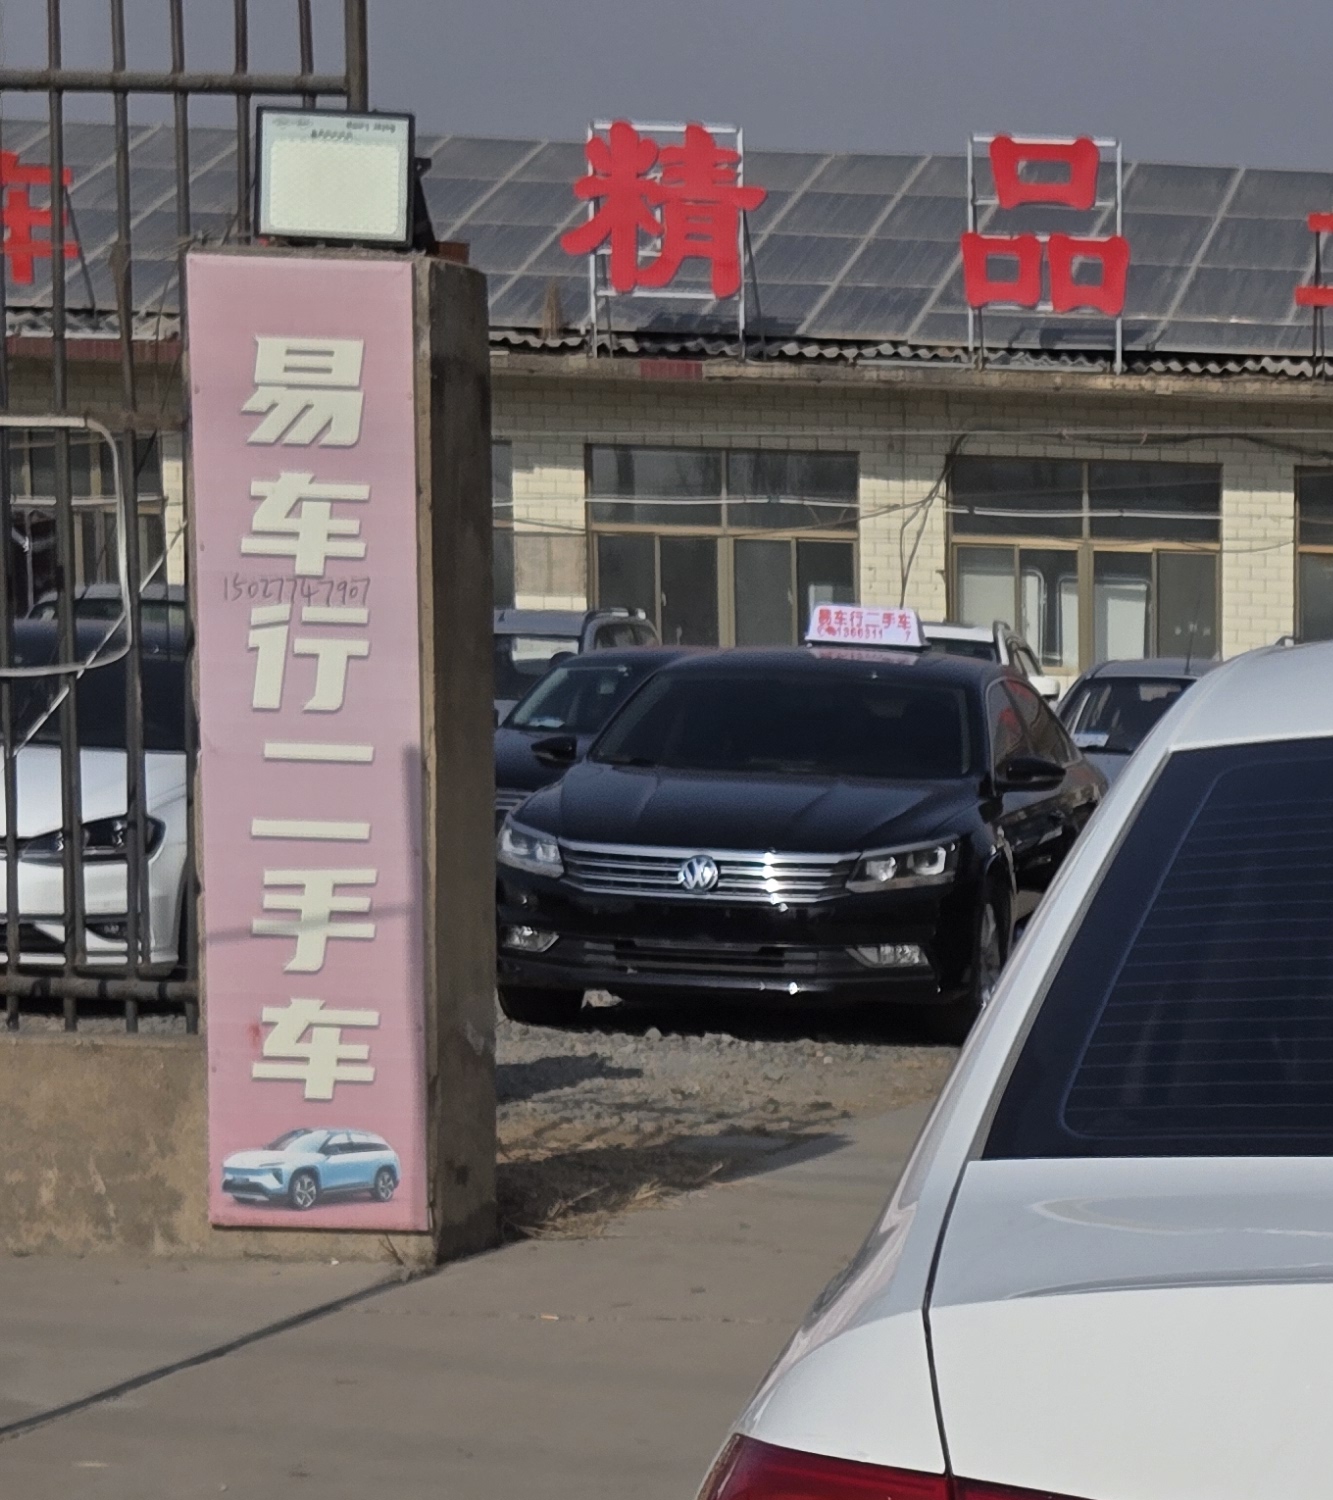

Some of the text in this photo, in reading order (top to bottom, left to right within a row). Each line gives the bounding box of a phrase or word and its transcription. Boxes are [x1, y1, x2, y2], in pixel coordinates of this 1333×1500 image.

[240, 334, 381, 1100] 易车行二手车
[818, 609, 911, 629] 易车行二手车
